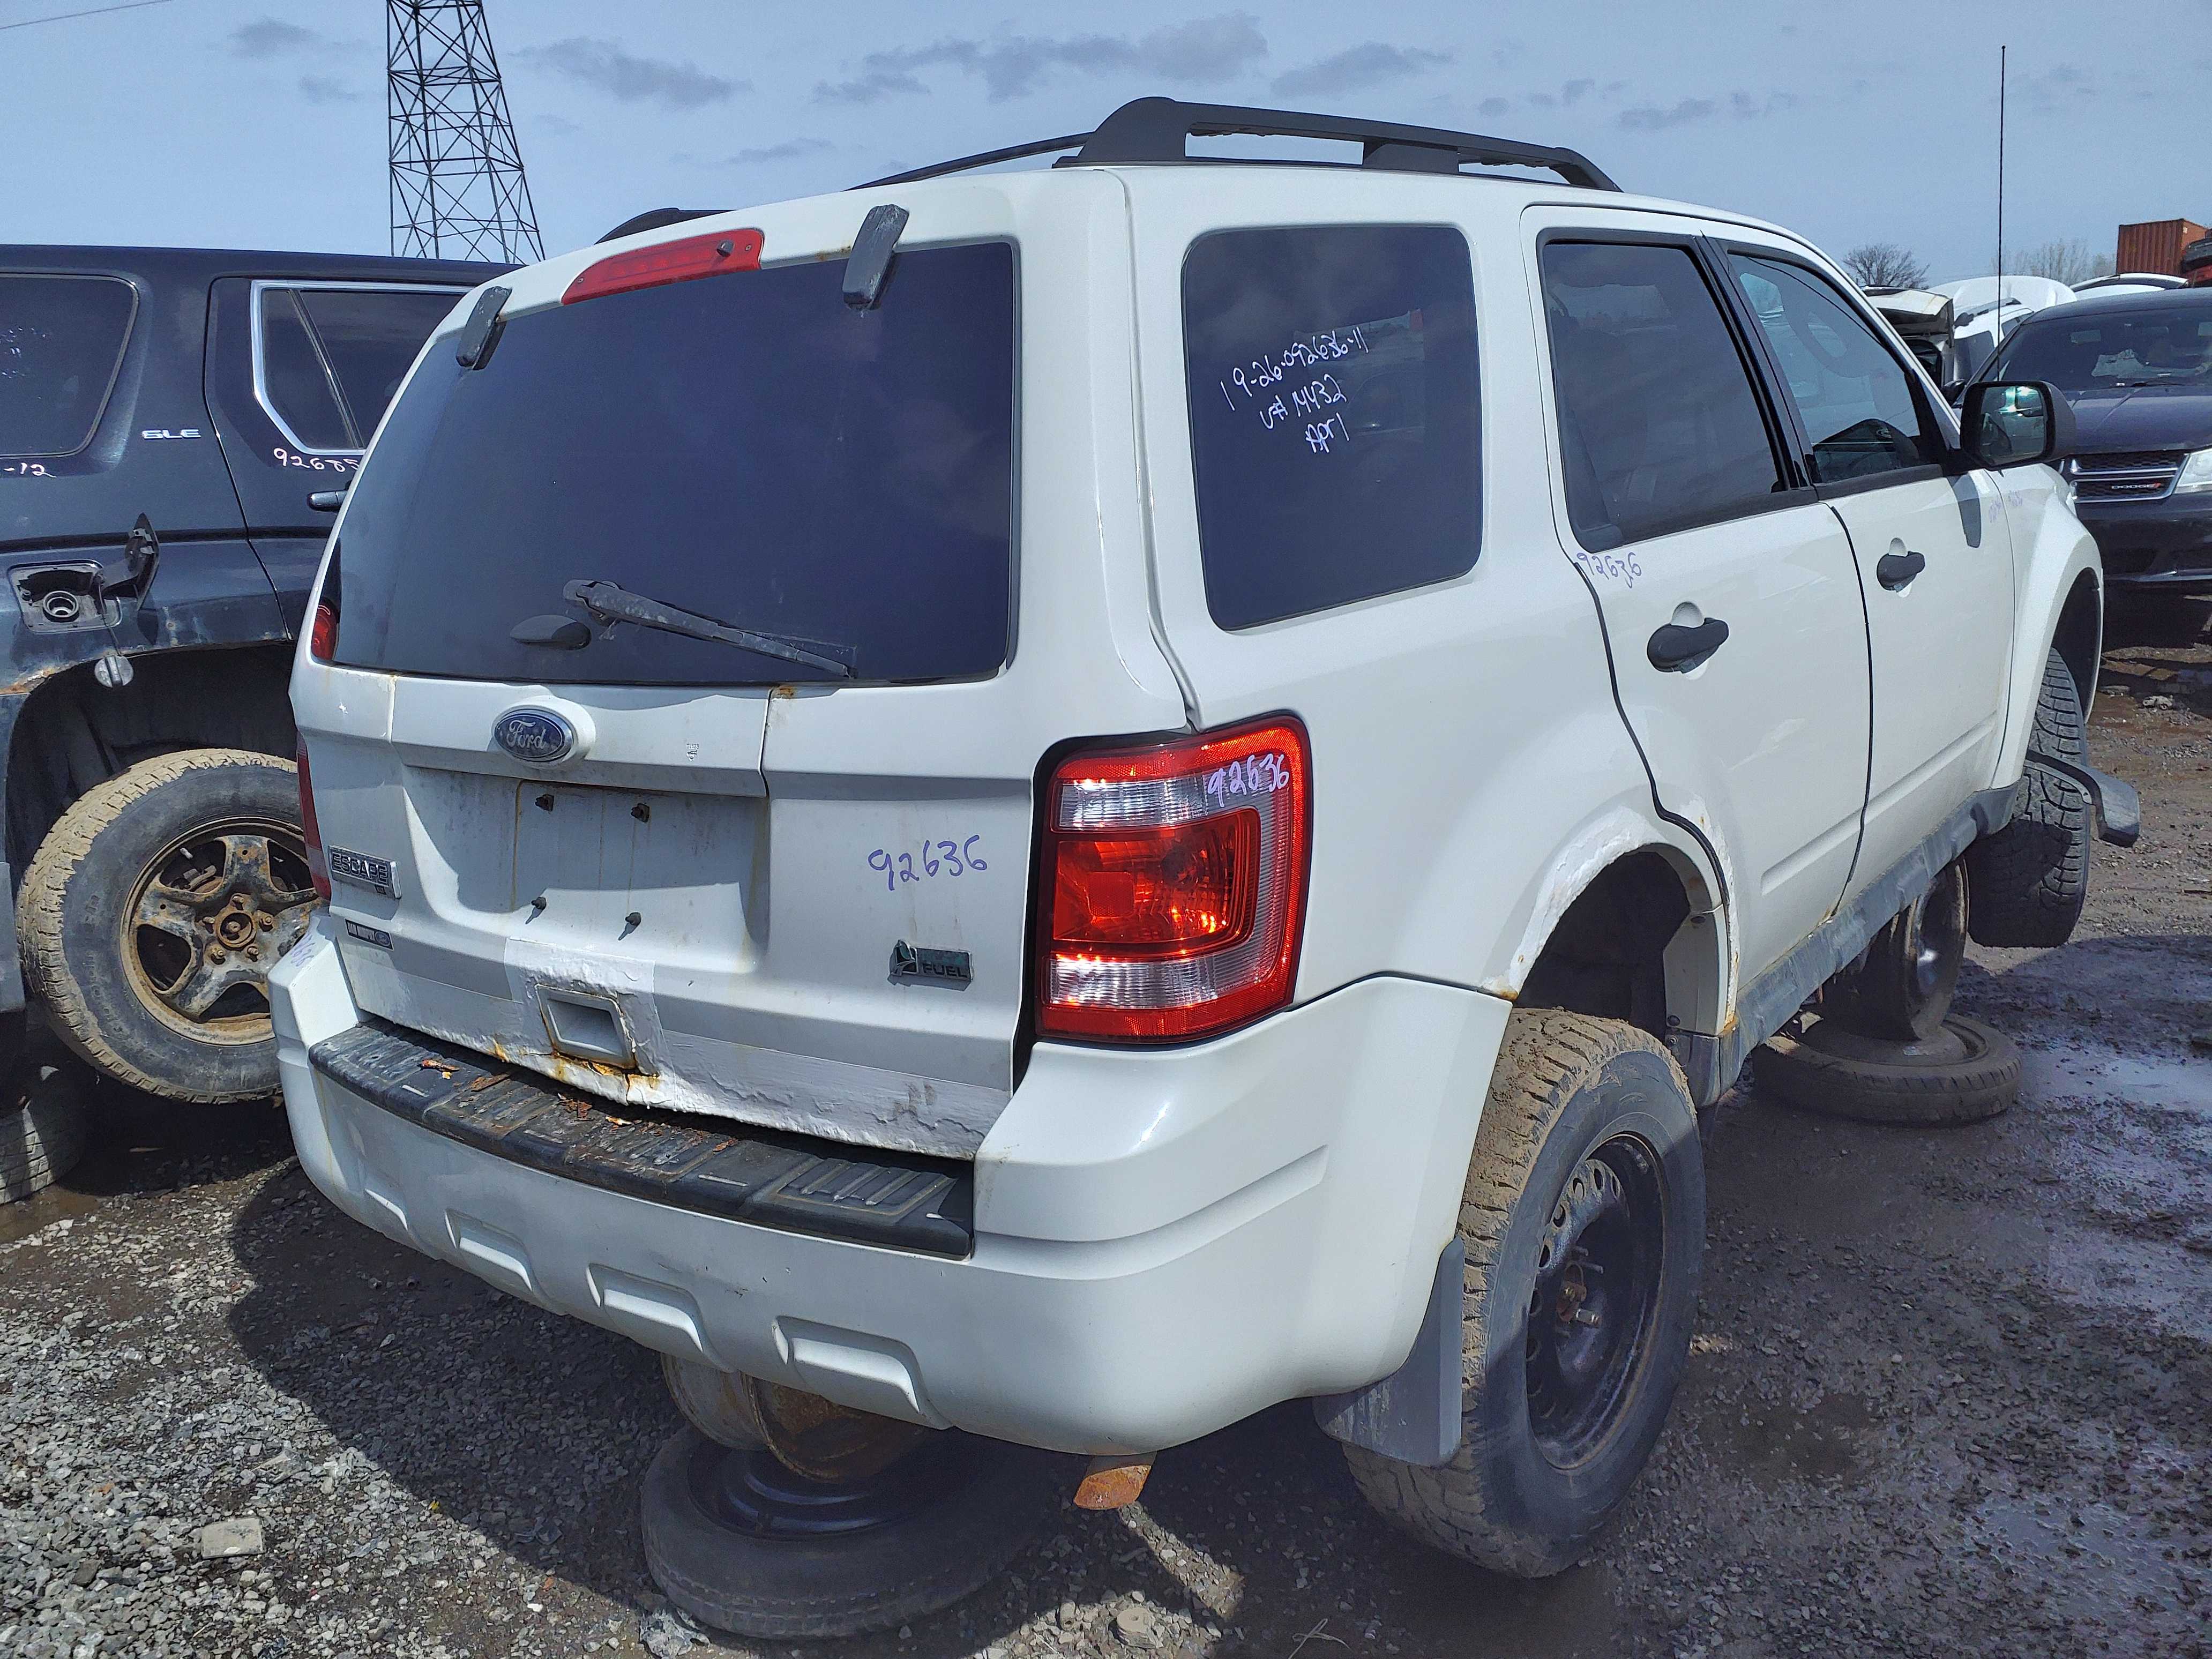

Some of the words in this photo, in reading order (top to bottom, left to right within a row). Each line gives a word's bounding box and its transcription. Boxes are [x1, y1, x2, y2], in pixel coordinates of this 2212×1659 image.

[141, 429, 201, 439] SLE
[506, 719, 548, 750] Ford
[1207, 753, 1290, 808] 92636
[332, 851, 389, 884] ESCAPE
[868, 834, 988, 891] 92636
[922, 962, 968, 978] FUEL
